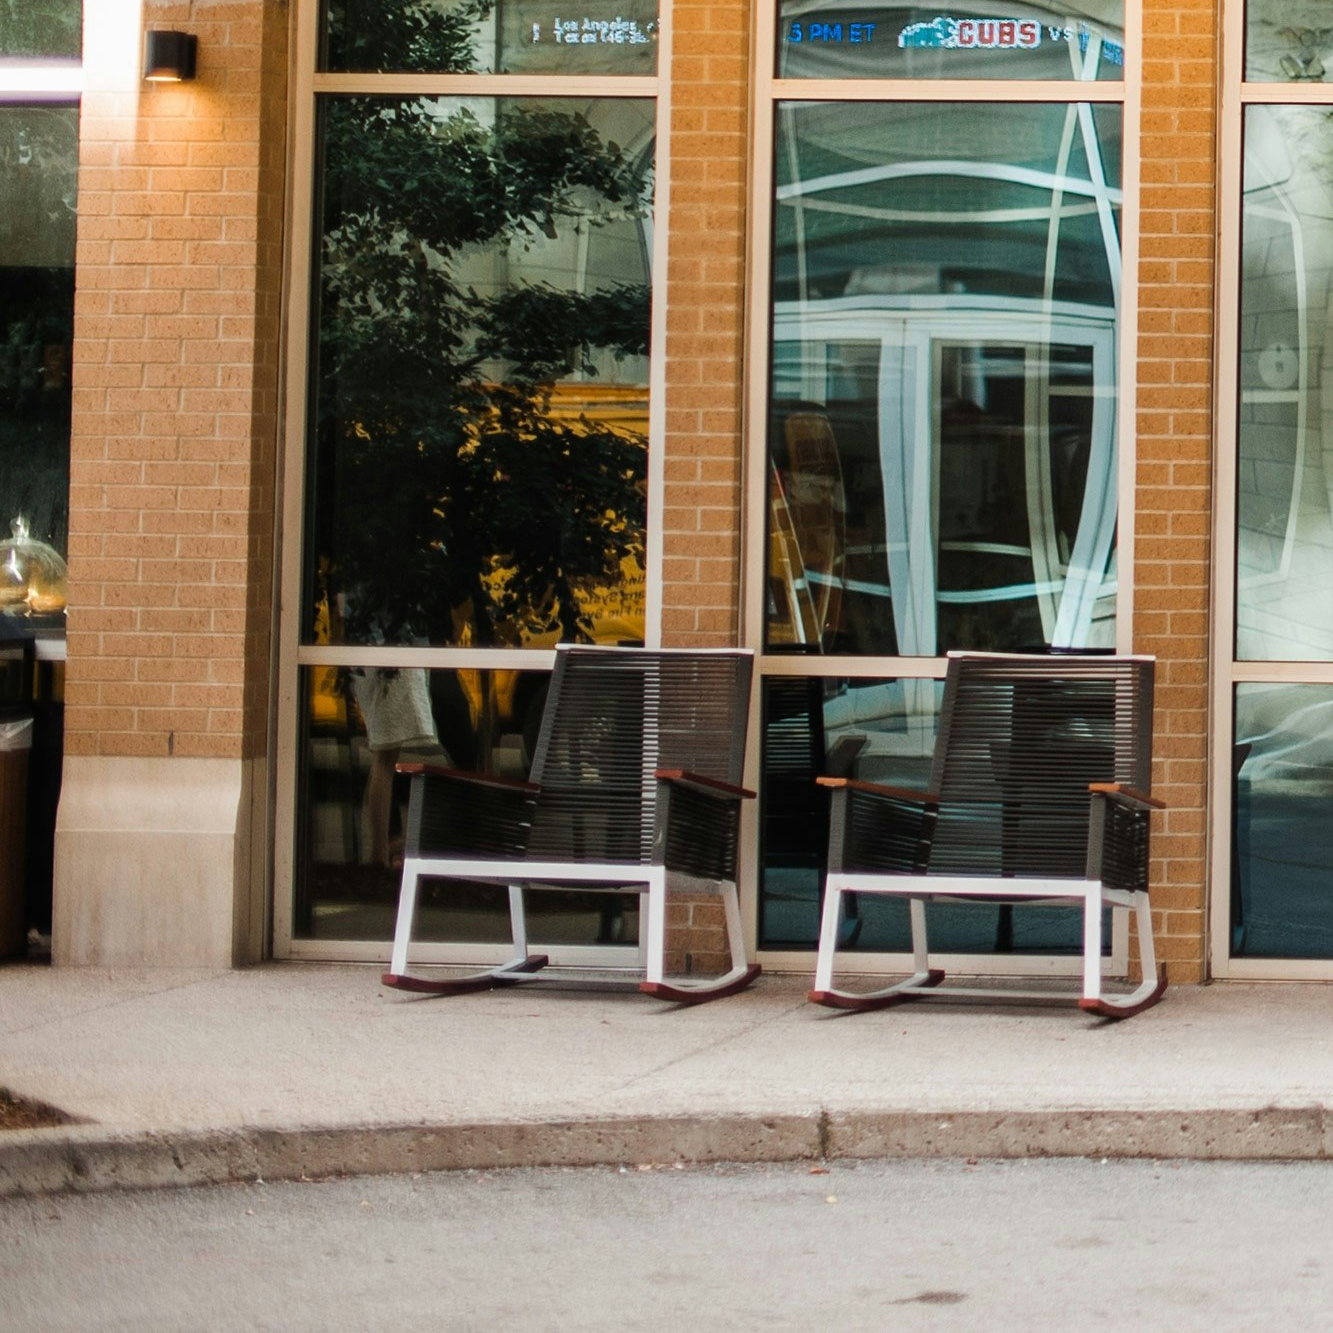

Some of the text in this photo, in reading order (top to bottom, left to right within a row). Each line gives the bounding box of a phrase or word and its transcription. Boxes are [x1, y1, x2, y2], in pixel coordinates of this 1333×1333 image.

[554, 17, 578, 31] Los
[582, 16, 637, 33] Angeles
[809, 23, 843, 42] PM
[850, 23, 877, 42] ET
[958, 21, 1038, 46] CUBS
